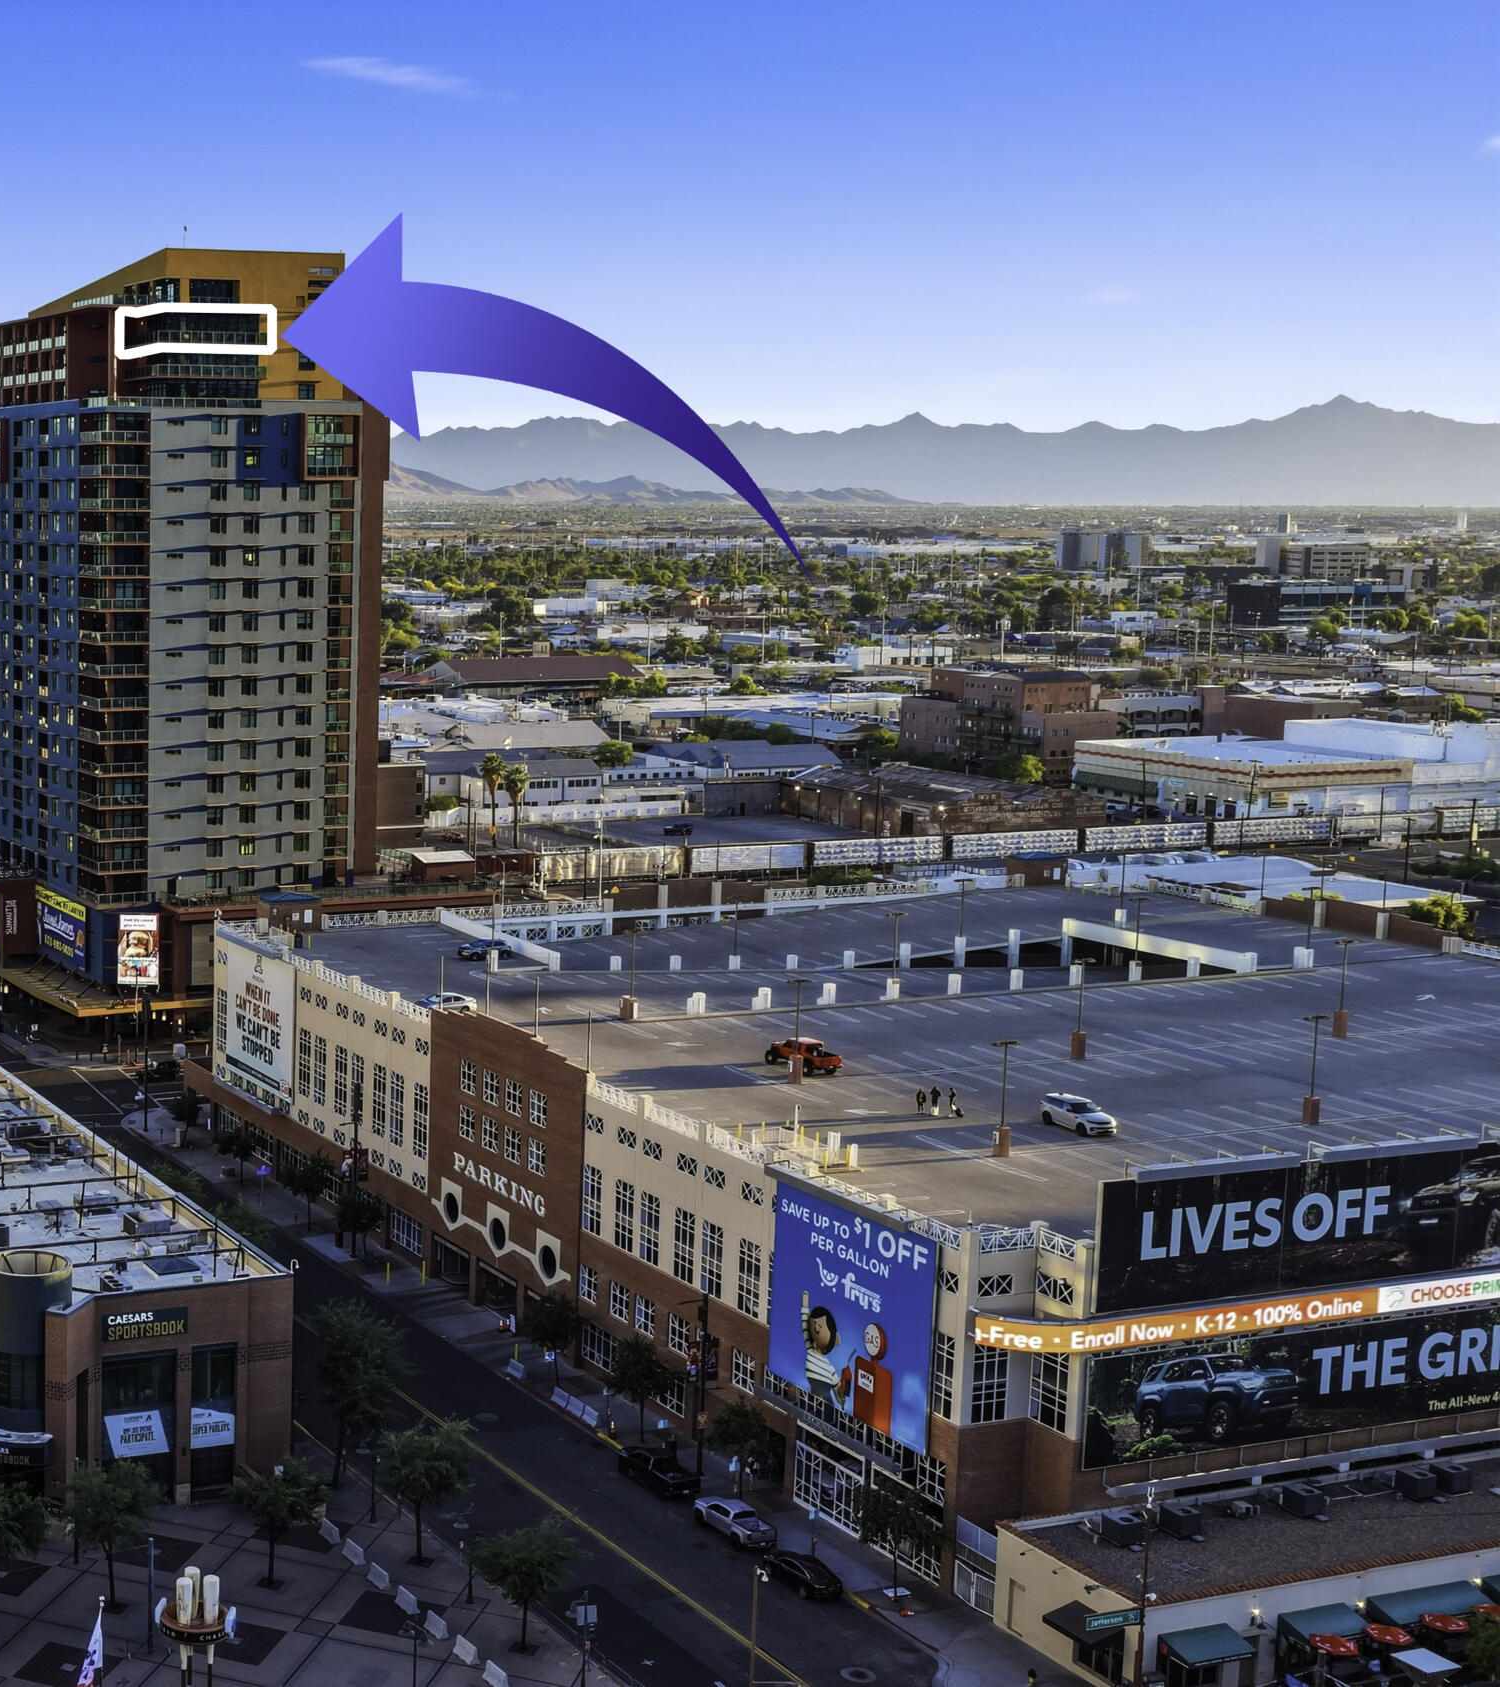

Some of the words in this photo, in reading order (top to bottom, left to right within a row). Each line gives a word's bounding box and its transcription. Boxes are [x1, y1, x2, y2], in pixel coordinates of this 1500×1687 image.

[245, 980, 263, 1003] WHEN
[263, 989, 271, 1005] IT
[235, 993, 252, 1015] CAN'T
[253, 1002, 261, 1020] BE
[262, 1006, 282, 1031] DONE,
[235, 1011, 247, 1033] WE
[247, 1018, 269, 1044] CAN'T
[270, 1030, 281, 1050] BE
[241, 1034, 274, 1066] STOPPED
[453, 1151, 546, 1217] PARKING
[781, 1199, 811, 1223] SAVE
[813, 1212, 830, 1230] UP
[832, 1221, 850, 1239] TO
[853, 1216, 871, 1249] $1
[877, 1230, 929, 1271] OFF
[1140, 1197, 1282, 1261] LIVES
[1292, 1185, 1391, 1242] OFF
[810, 1232, 834, 1254] PER
[841, 1272, 882, 1313] fry's
[107, 1311, 154, 1326] CAESARS
[107, 1319, 185, 1341] SPORTSBOOK
[1070, 1325, 1125, 1350] Enroll
[1130, 1323, 1175, 1343] Now
[1194, 1312, 1237, 1334] K-12
[1254, 1303, 1302, 1326] 100%
[1306, 1298, 1364, 1320] Online
[864, 1331, 879, 1348] GAS
[1311, 1337, 1409, 1396] THE
[1428, 1399, 1447, 1411] The
[1448, 1393, 1491, 1409] All-New
